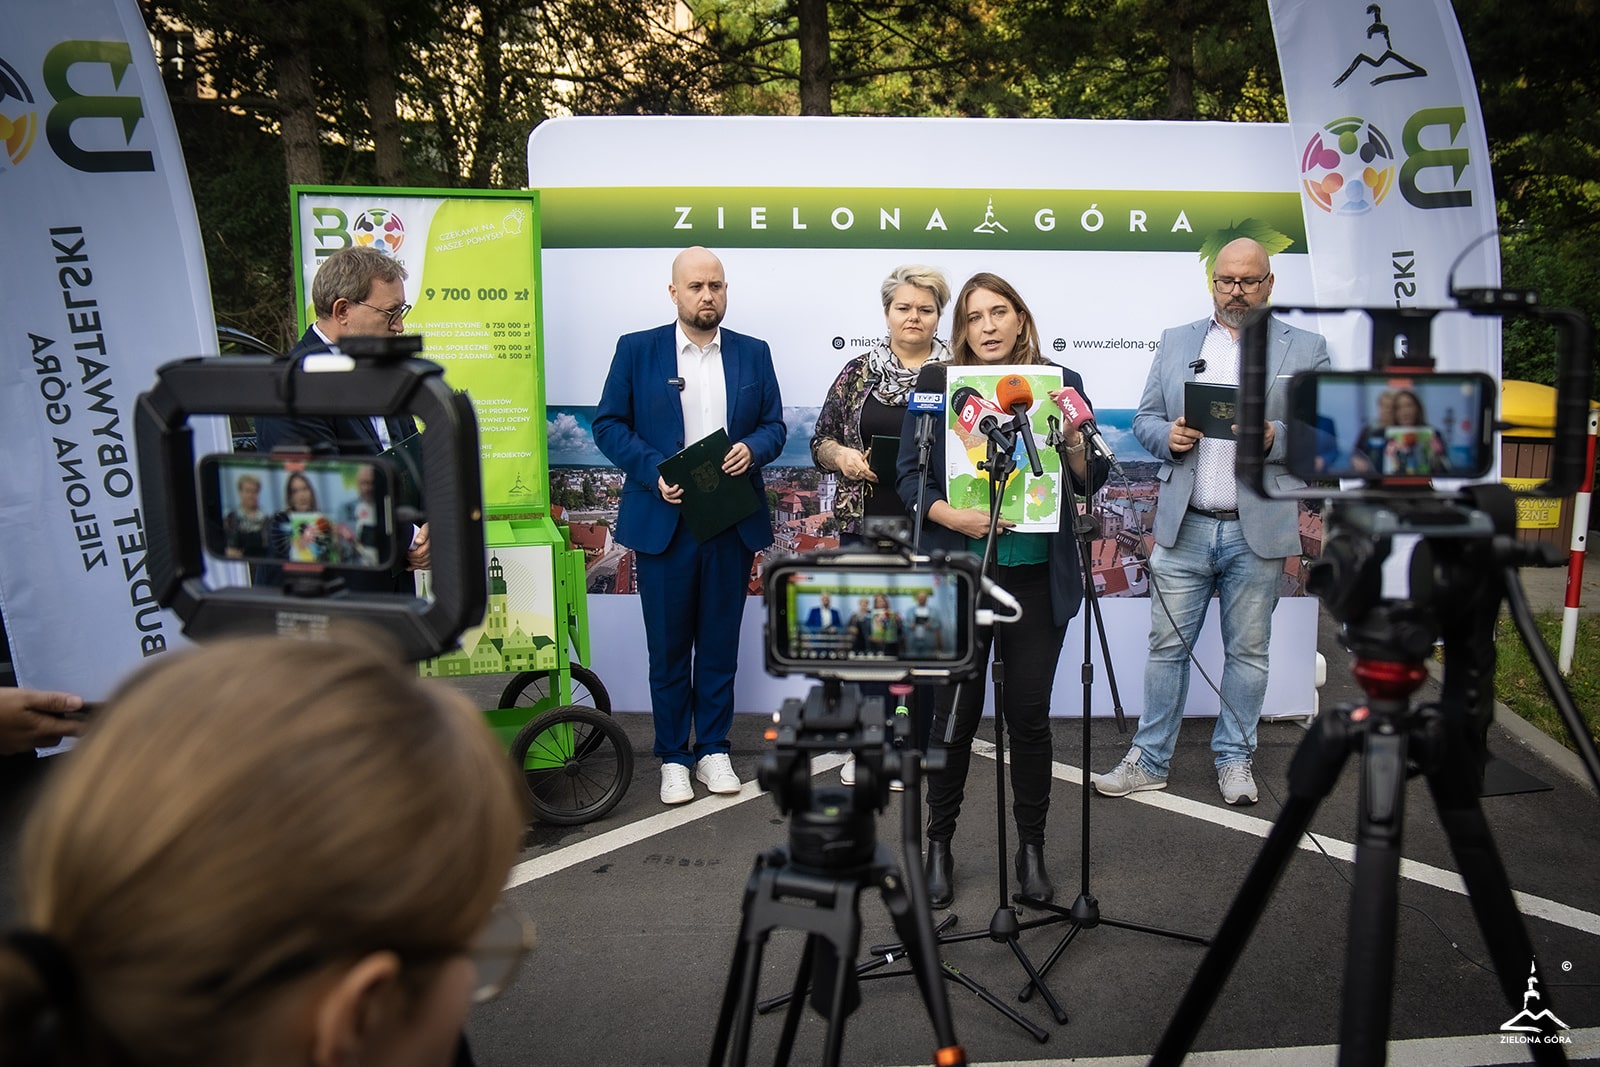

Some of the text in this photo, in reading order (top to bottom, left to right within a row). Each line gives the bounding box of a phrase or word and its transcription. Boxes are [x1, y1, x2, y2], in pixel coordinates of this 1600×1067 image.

[674, 203, 1193, 233] ZIELONA GÓRA
[439, 223, 495, 241] CZEKAMY NA
[434, 231, 504, 252] WASZE POMYSŁY
[425, 288, 530, 301] 9 700 000 zł
[850, 336, 881, 347] miast
[489, 406, 529, 415] PROJEKTÓW
[507, 415, 531, 423] OCENY
[492, 451, 533, 459] PROJEKTÓW
[1516, 497, 1558, 508] ZYWA
